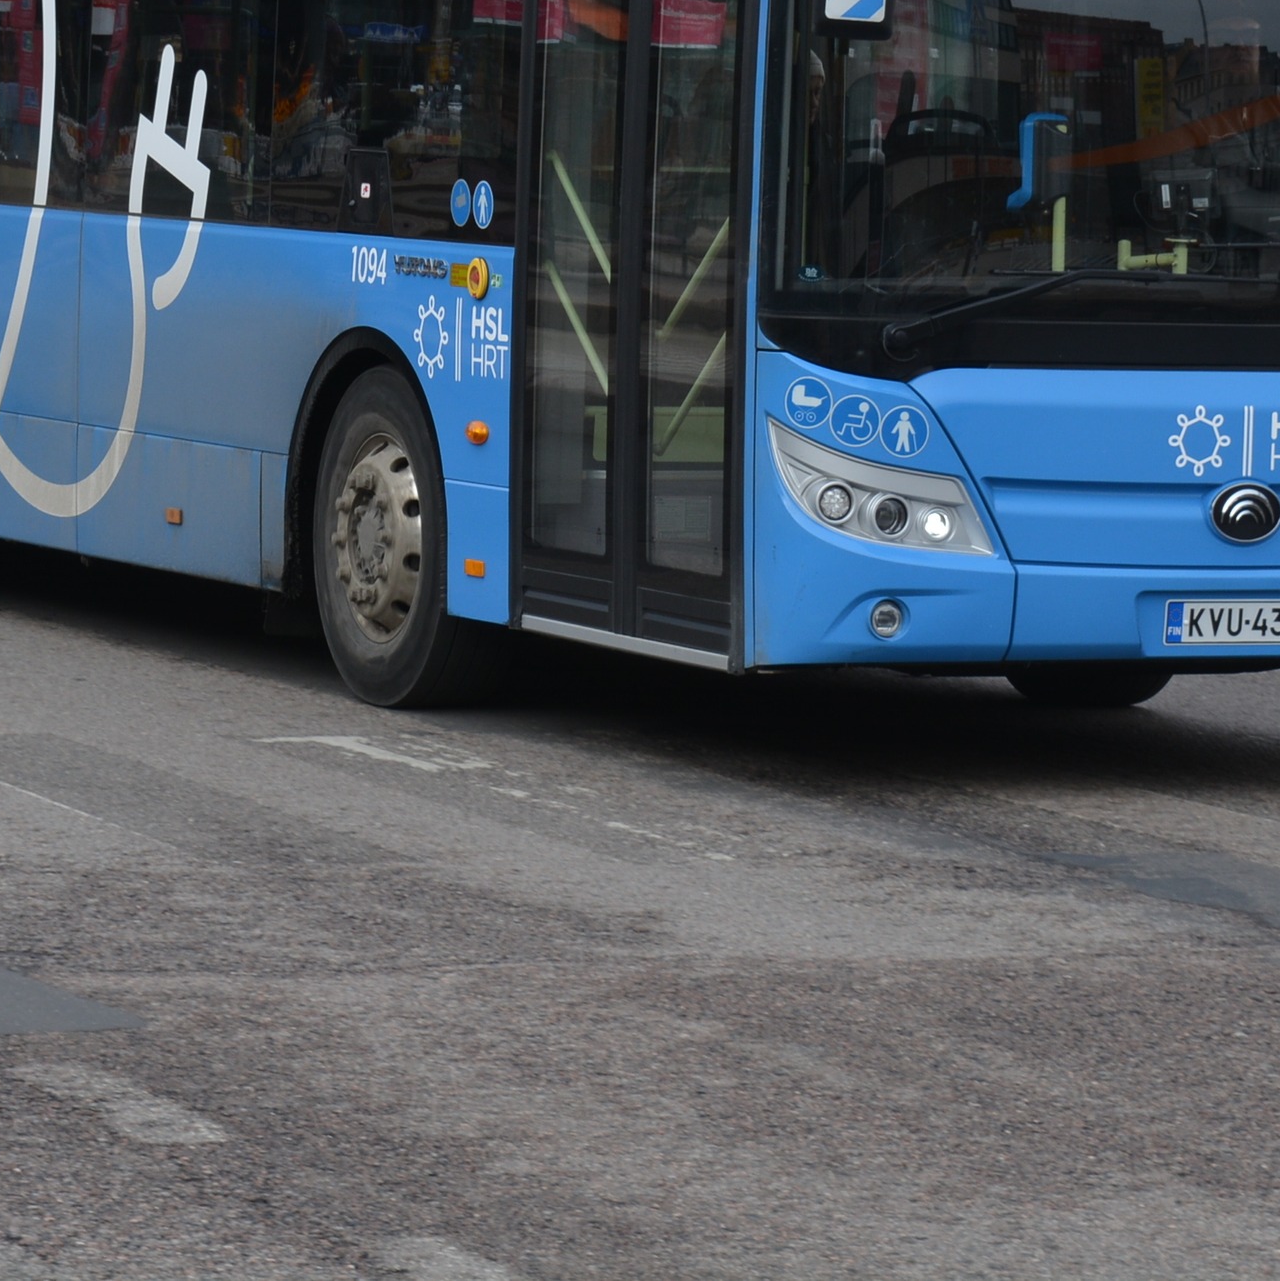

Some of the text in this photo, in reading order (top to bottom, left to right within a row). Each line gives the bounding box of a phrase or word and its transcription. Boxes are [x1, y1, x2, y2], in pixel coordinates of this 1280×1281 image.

[351, 245, 388, 286] 1094
[471, 305, 509, 343] HSL
[470, 343, 509, 380] HRT
[1167, 626, 1181, 636] FIN
